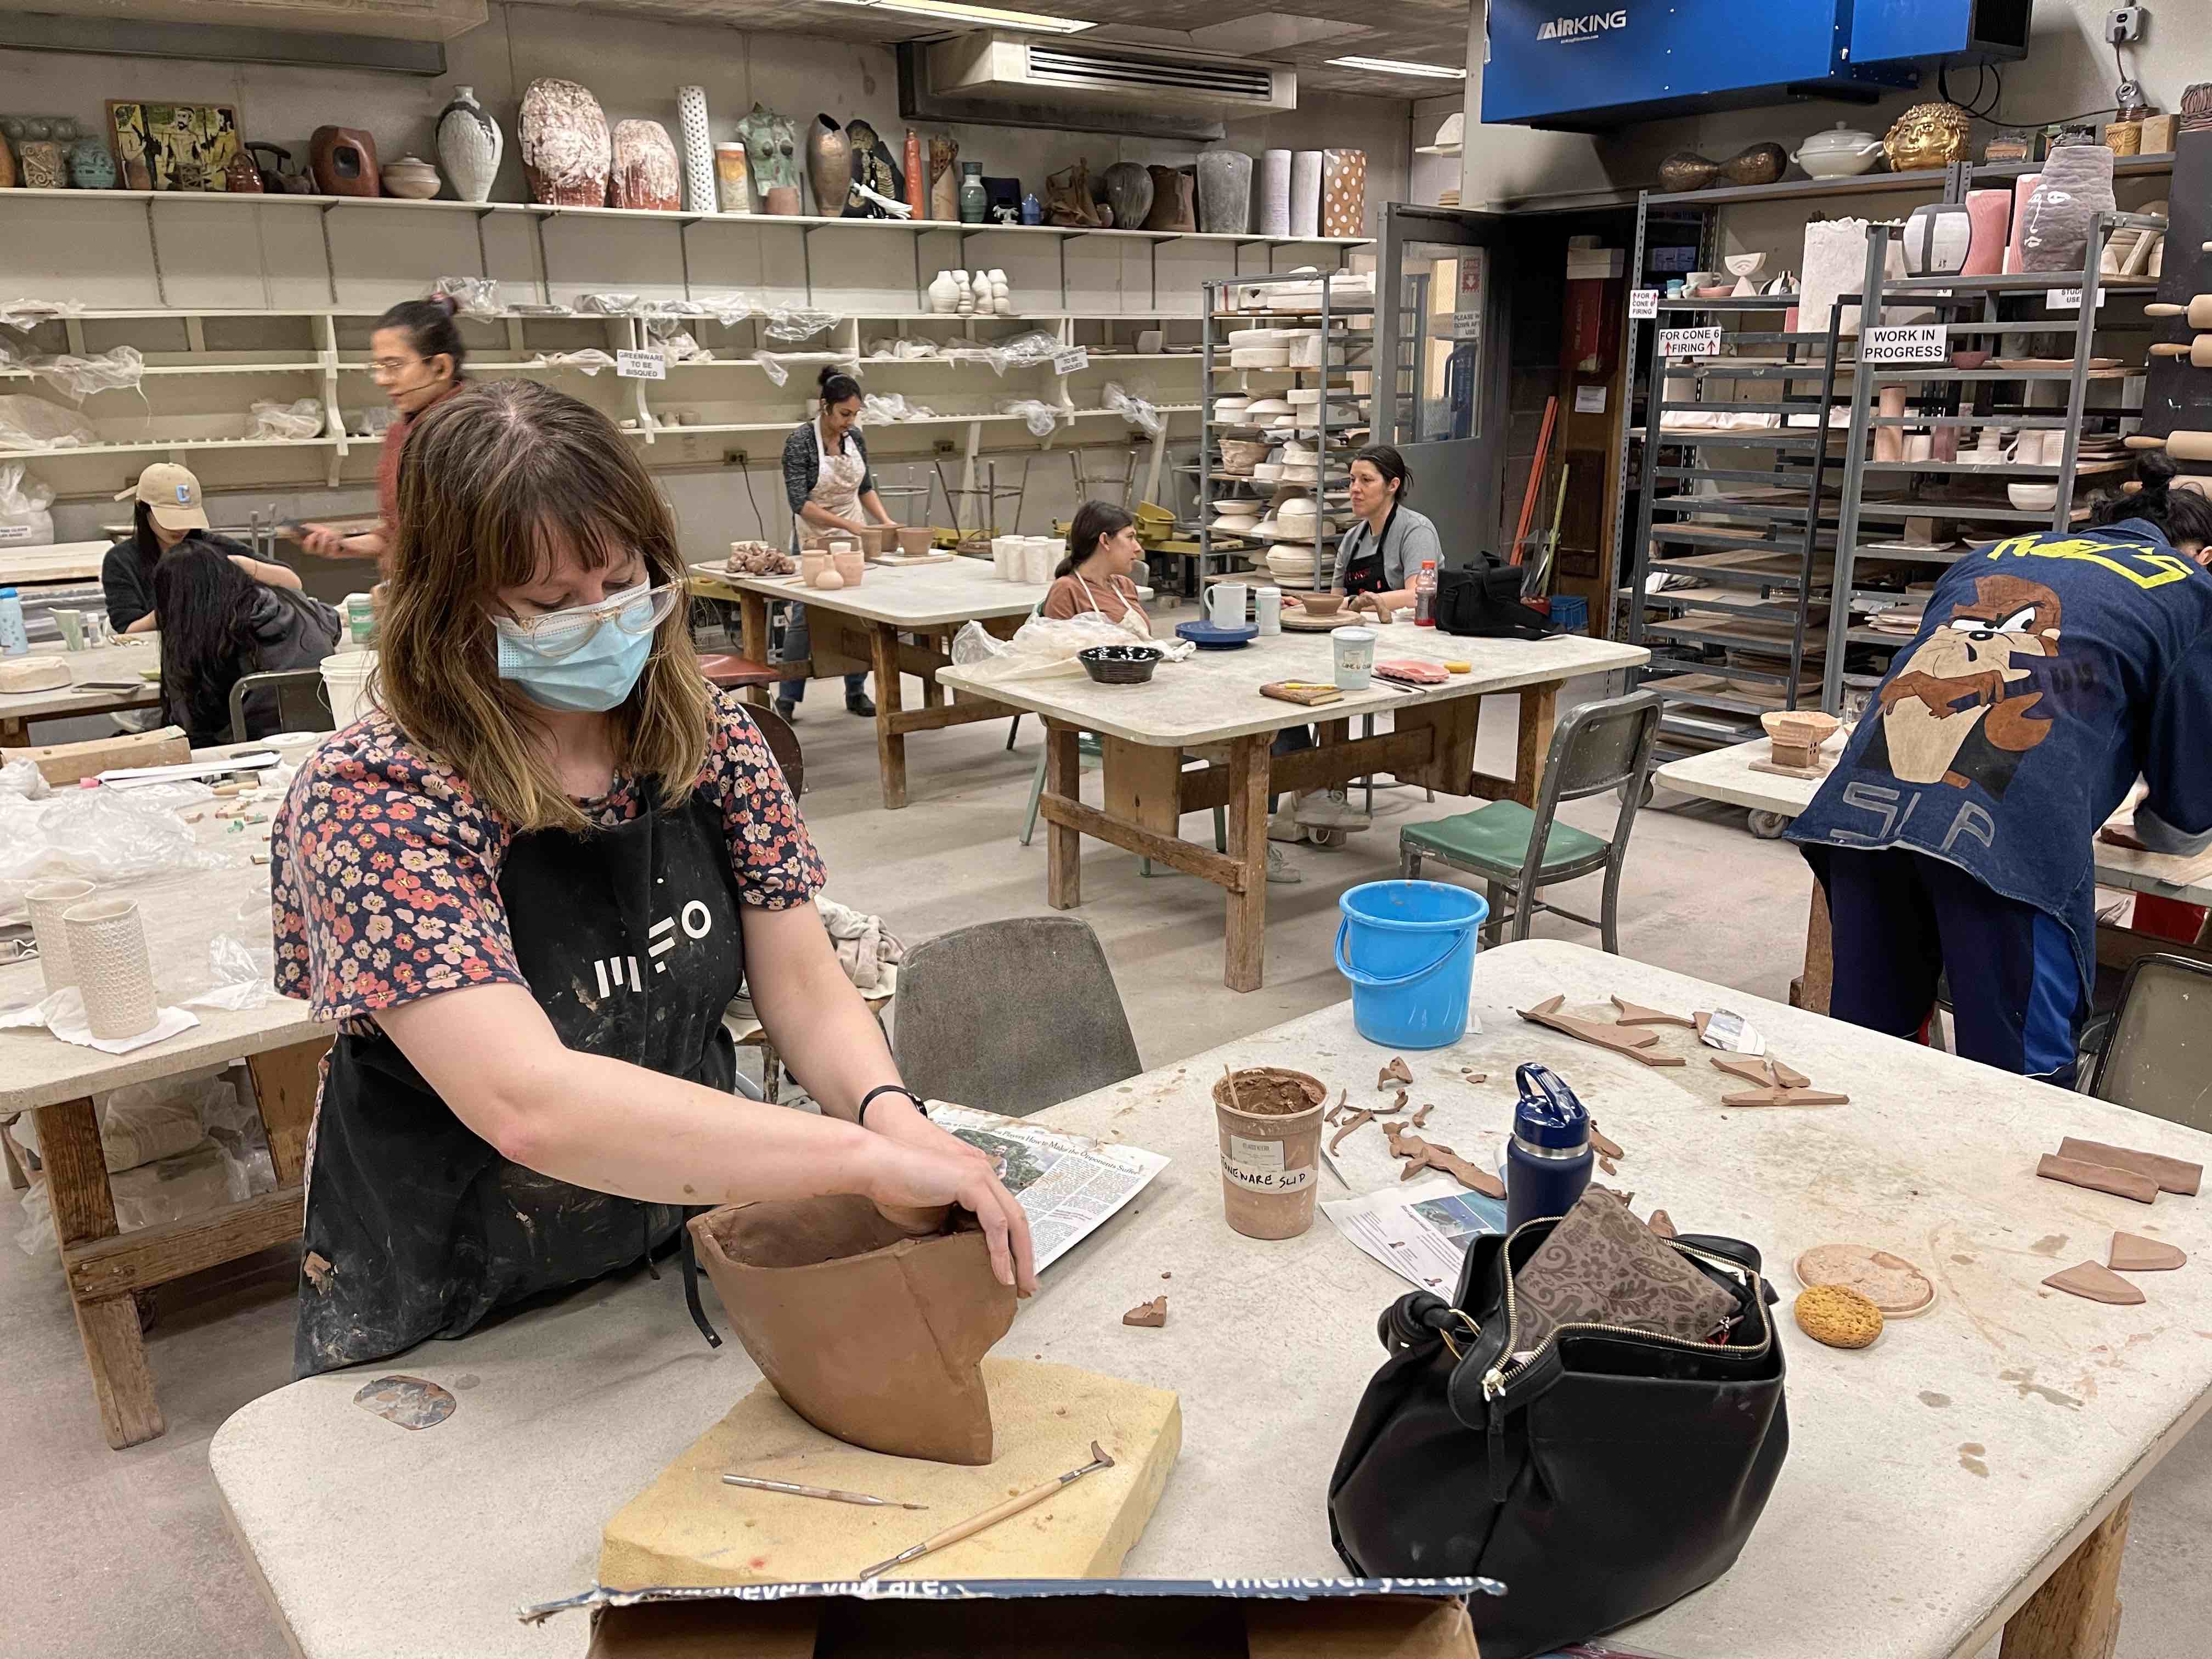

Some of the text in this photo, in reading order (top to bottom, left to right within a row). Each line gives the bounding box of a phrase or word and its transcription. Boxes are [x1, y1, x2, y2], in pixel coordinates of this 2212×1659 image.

[1660, 329, 1719, 341] FOR CONE 6
[1874, 329, 1935, 342] WORK IN
[1672, 343, 1705, 353] FIRING
[1865, 346, 1943, 359] PROGRESS
[618, 351, 663, 361] GREENWARE
[625, 369, 657, 377] BISQUED
[1025, 1135, 1042, 1145] How
[1080, 1150, 1116, 1169] Opponents
[1221, 1156, 1306, 1188] TONEWARE SLIP
